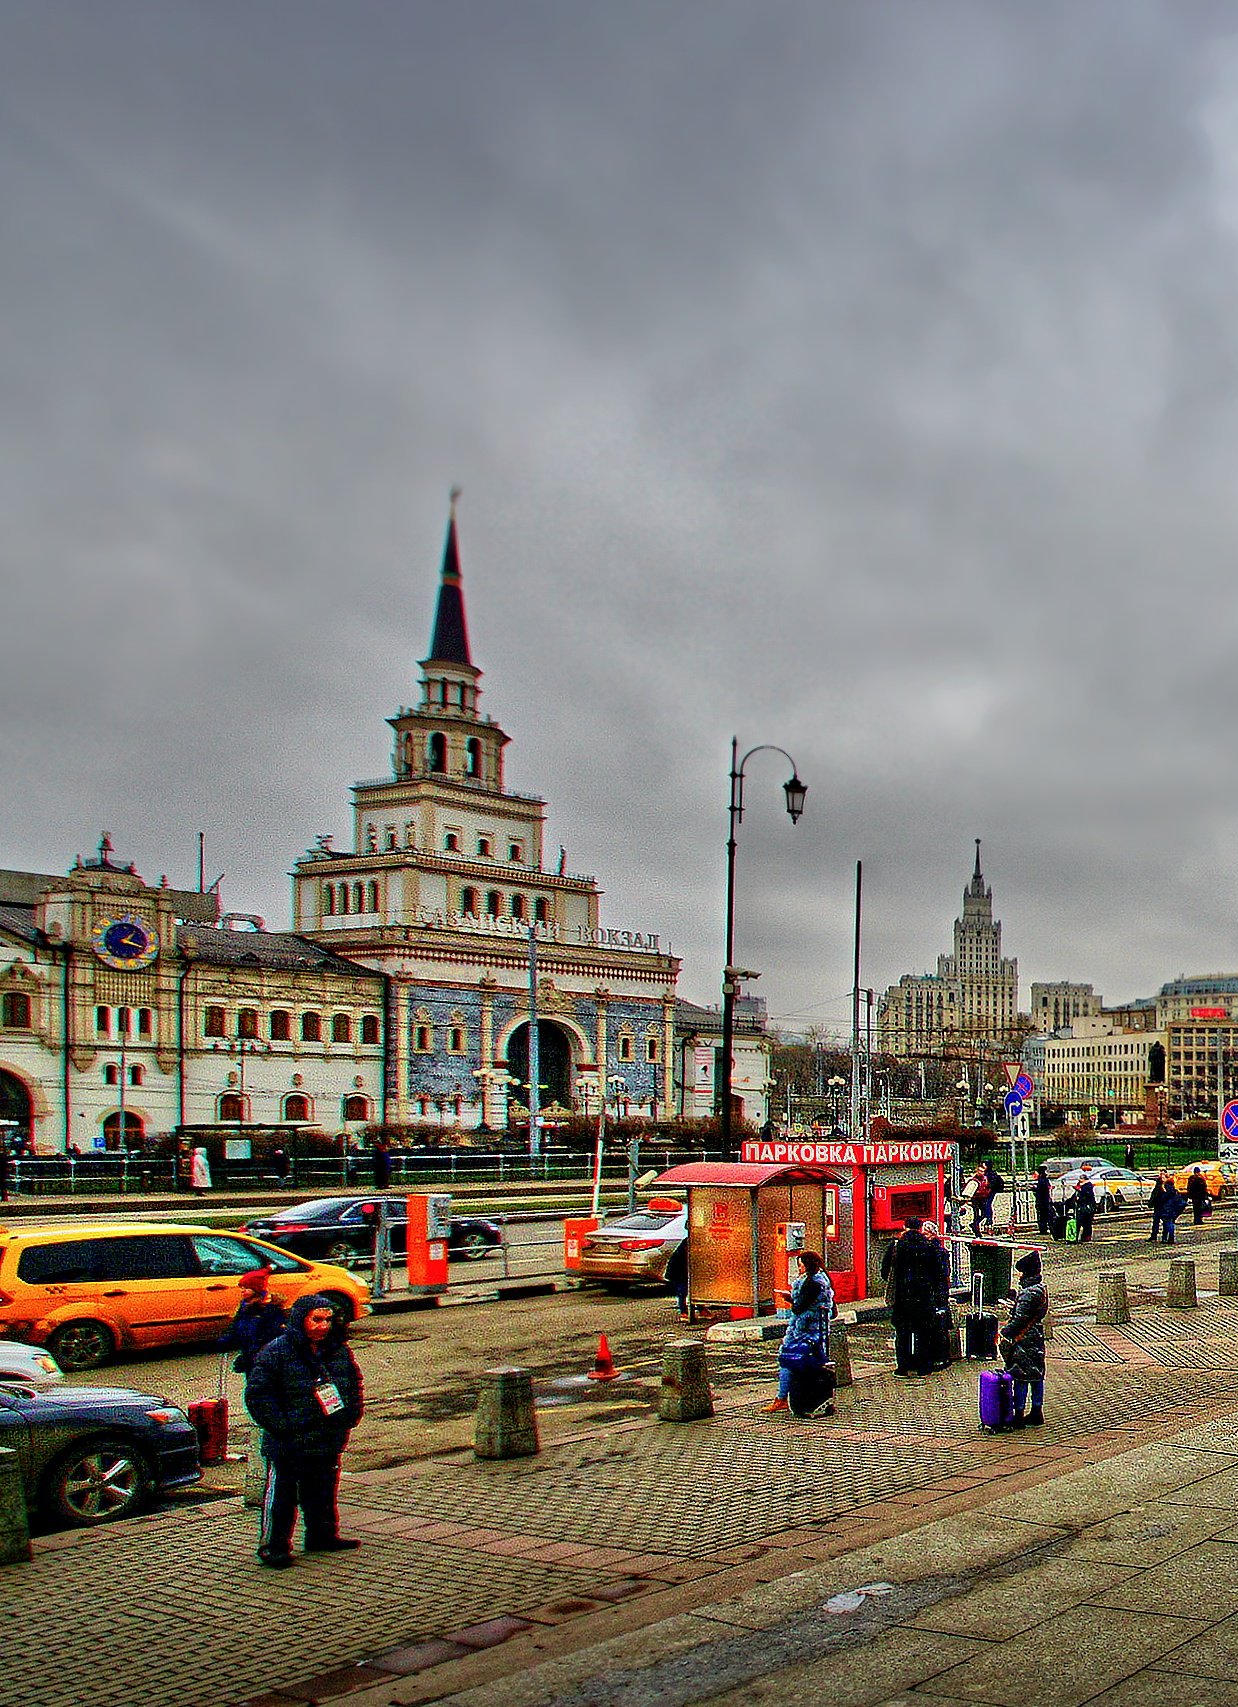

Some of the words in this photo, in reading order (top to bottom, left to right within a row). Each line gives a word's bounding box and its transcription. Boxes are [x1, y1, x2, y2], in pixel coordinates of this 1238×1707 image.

[577, 924, 660, 951] ВОКЗАЛ
[745, 1143, 857, 1163] ПАРКОВКА
[863, 1144, 953, 1162] ПАРКОВКА
